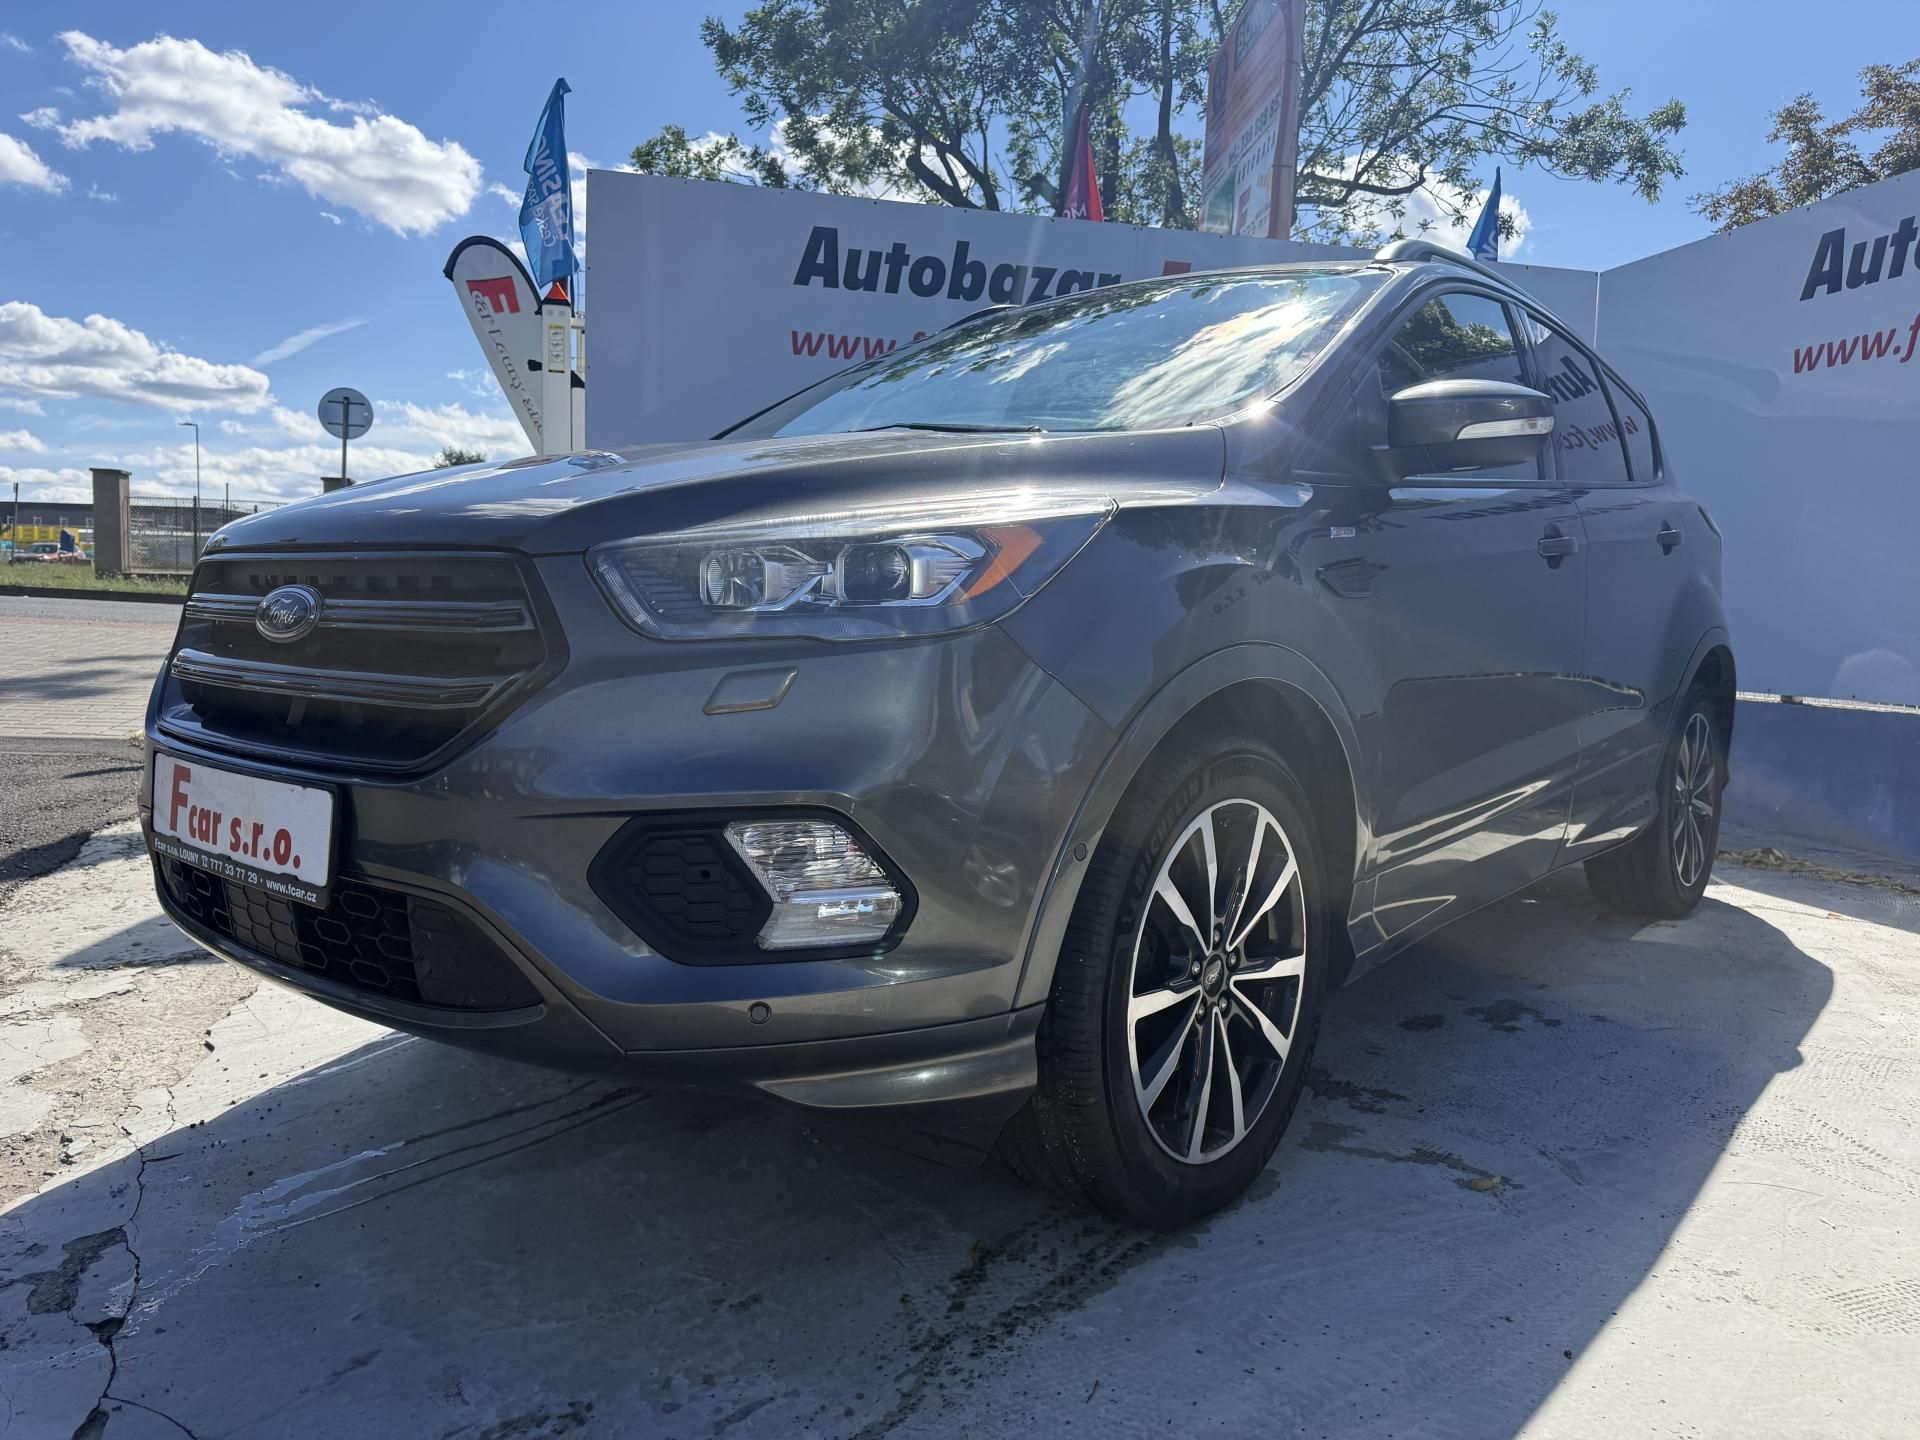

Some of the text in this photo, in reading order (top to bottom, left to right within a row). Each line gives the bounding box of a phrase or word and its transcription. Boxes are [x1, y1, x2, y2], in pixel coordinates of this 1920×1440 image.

[1800, 215, 1920, 301] Aut
[264, 597, 299, 625] Ford
[169, 763, 301, 869] Fcar s.r.o.
[154, 837, 166, 851] Fcar
[180, 848, 199, 864] LOUNY
[210, 859, 223, 871] 777
[225, 863, 234, 876] 33
[236, 867, 246, 880] 77
[247, 871, 258, 884] 29
[266, 879, 317, 903] www.fcar.cz
